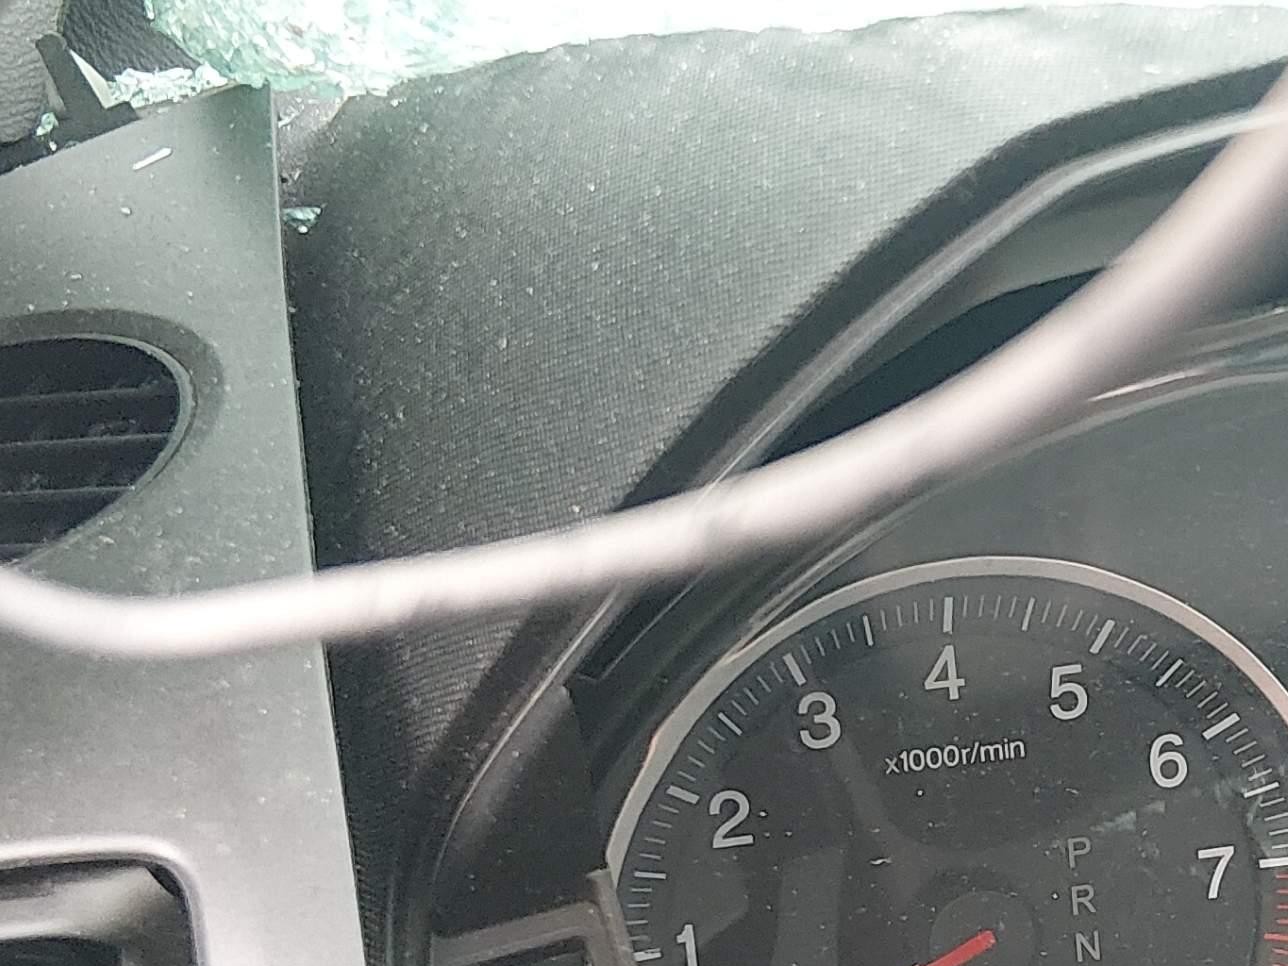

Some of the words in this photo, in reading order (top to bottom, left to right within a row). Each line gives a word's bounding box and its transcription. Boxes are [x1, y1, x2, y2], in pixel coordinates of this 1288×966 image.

[924, 645, 966, 700] 4
[1050, 664, 1088, 720] 5
[798, 692, 842, 749] 3
[885, 738, 1026, 775] x1000r/min
[1149, 733, 1188, 788] 6
[708, 789, 754, 848] 2
[1067, 837, 1091, 868] P
[1198, 846, 1235, 899] 7
[1071, 884, 1096, 915] R
[1075, 930, 1101, 962] N
